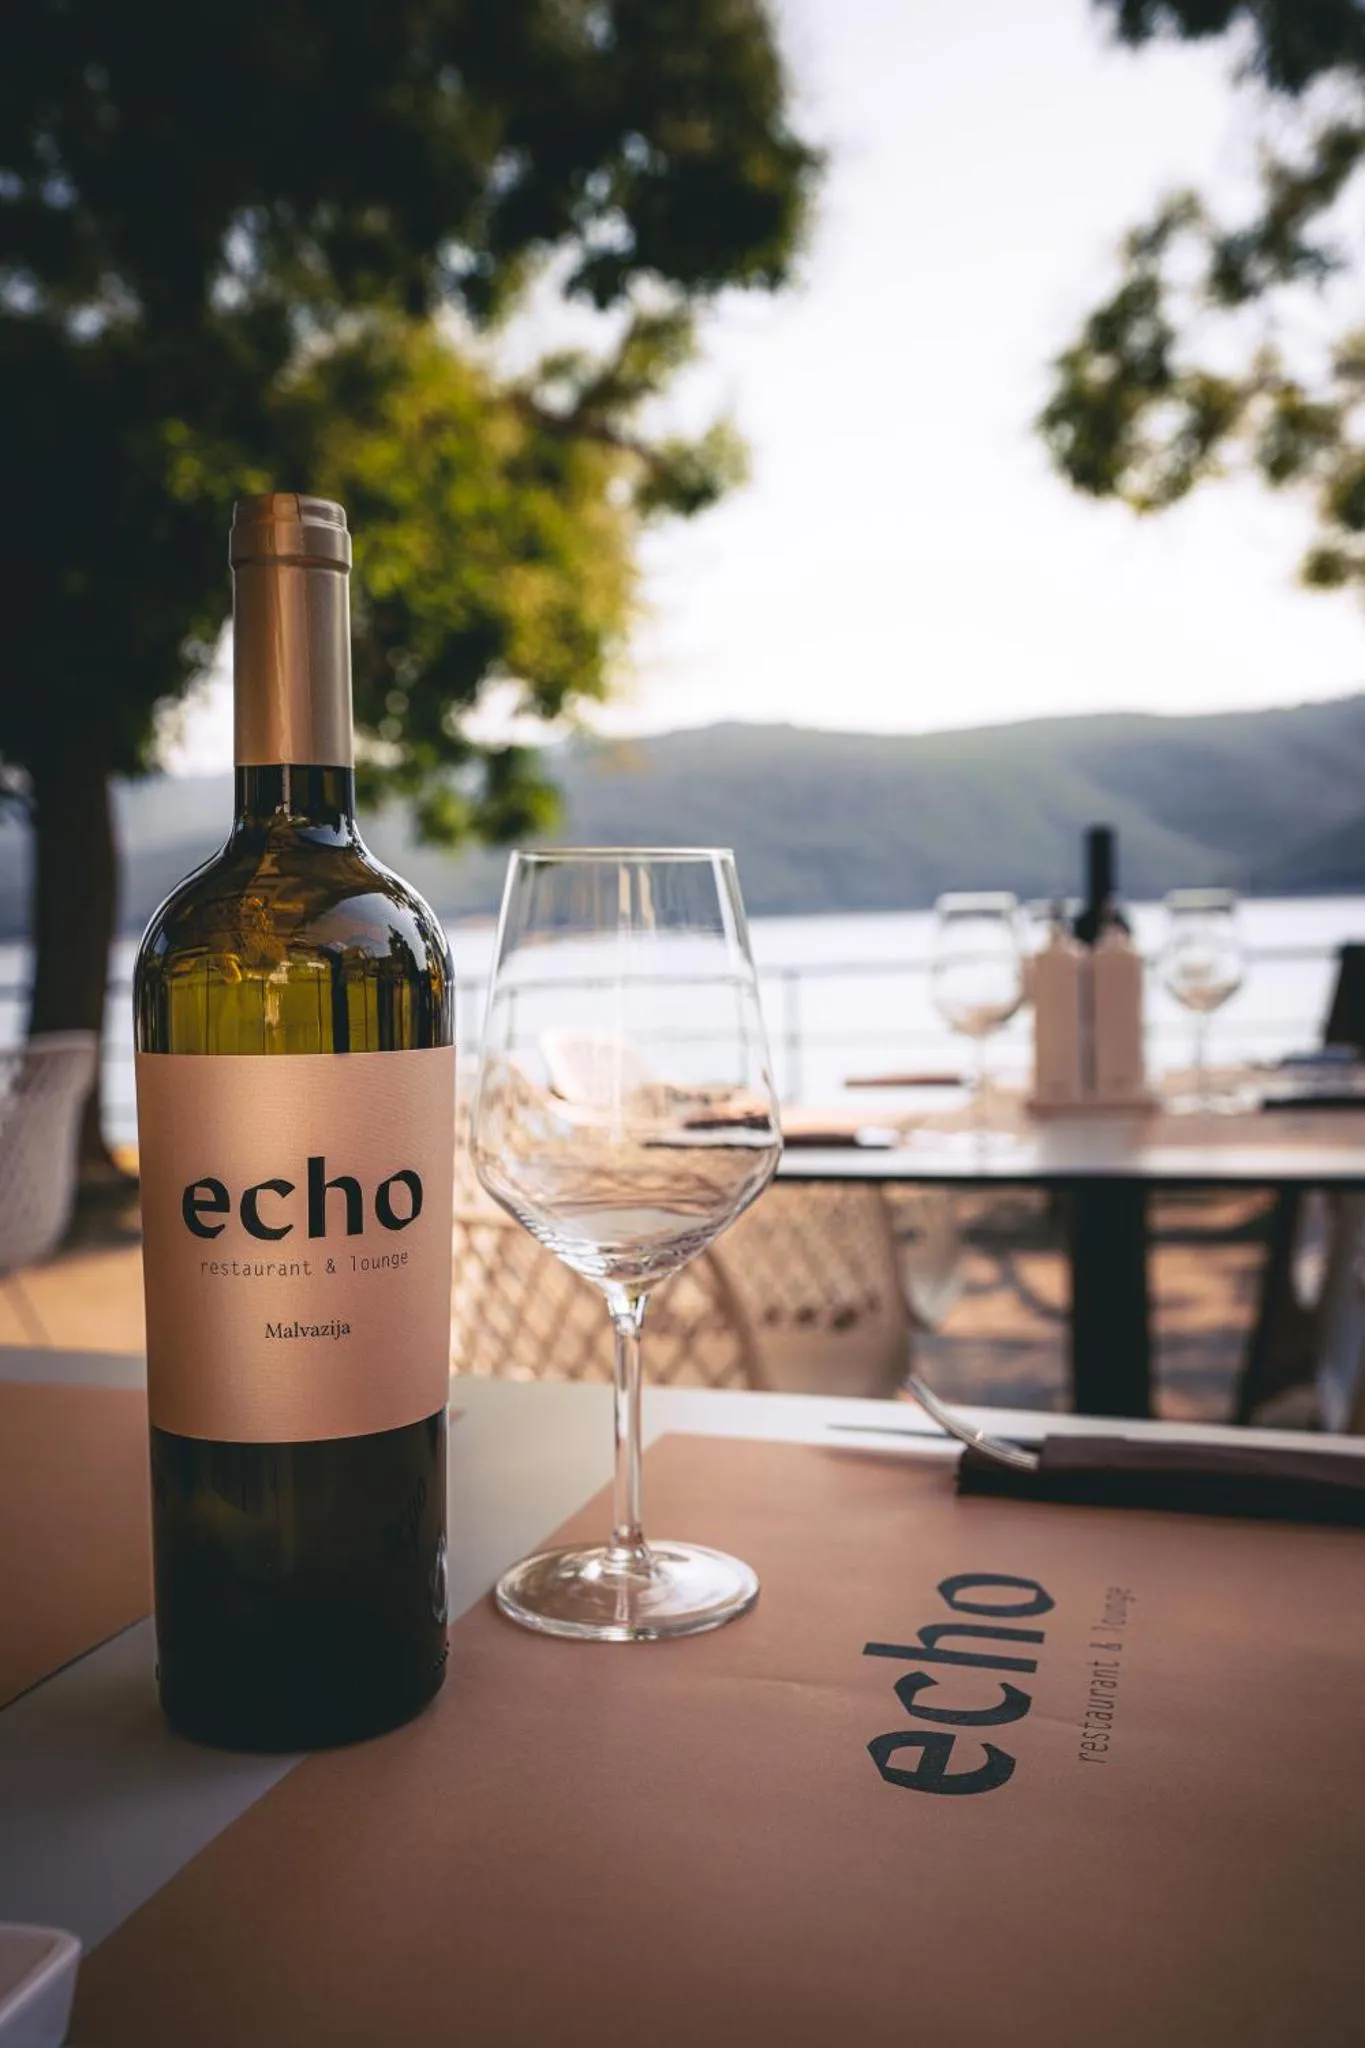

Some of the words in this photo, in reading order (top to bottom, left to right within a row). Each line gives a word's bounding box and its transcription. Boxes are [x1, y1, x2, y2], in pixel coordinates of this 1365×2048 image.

[182, 1156, 424, 1241] echo
[200, 1258, 313, 1278] restaurant
[326, 1257, 337, 1275] &
[351, 1250, 409, 1273] lounge
[264, 1321, 351, 1340] Malvazija
[862, 1573, 1055, 1795] echo
[1078, 1660, 1120, 1764] restaurant
